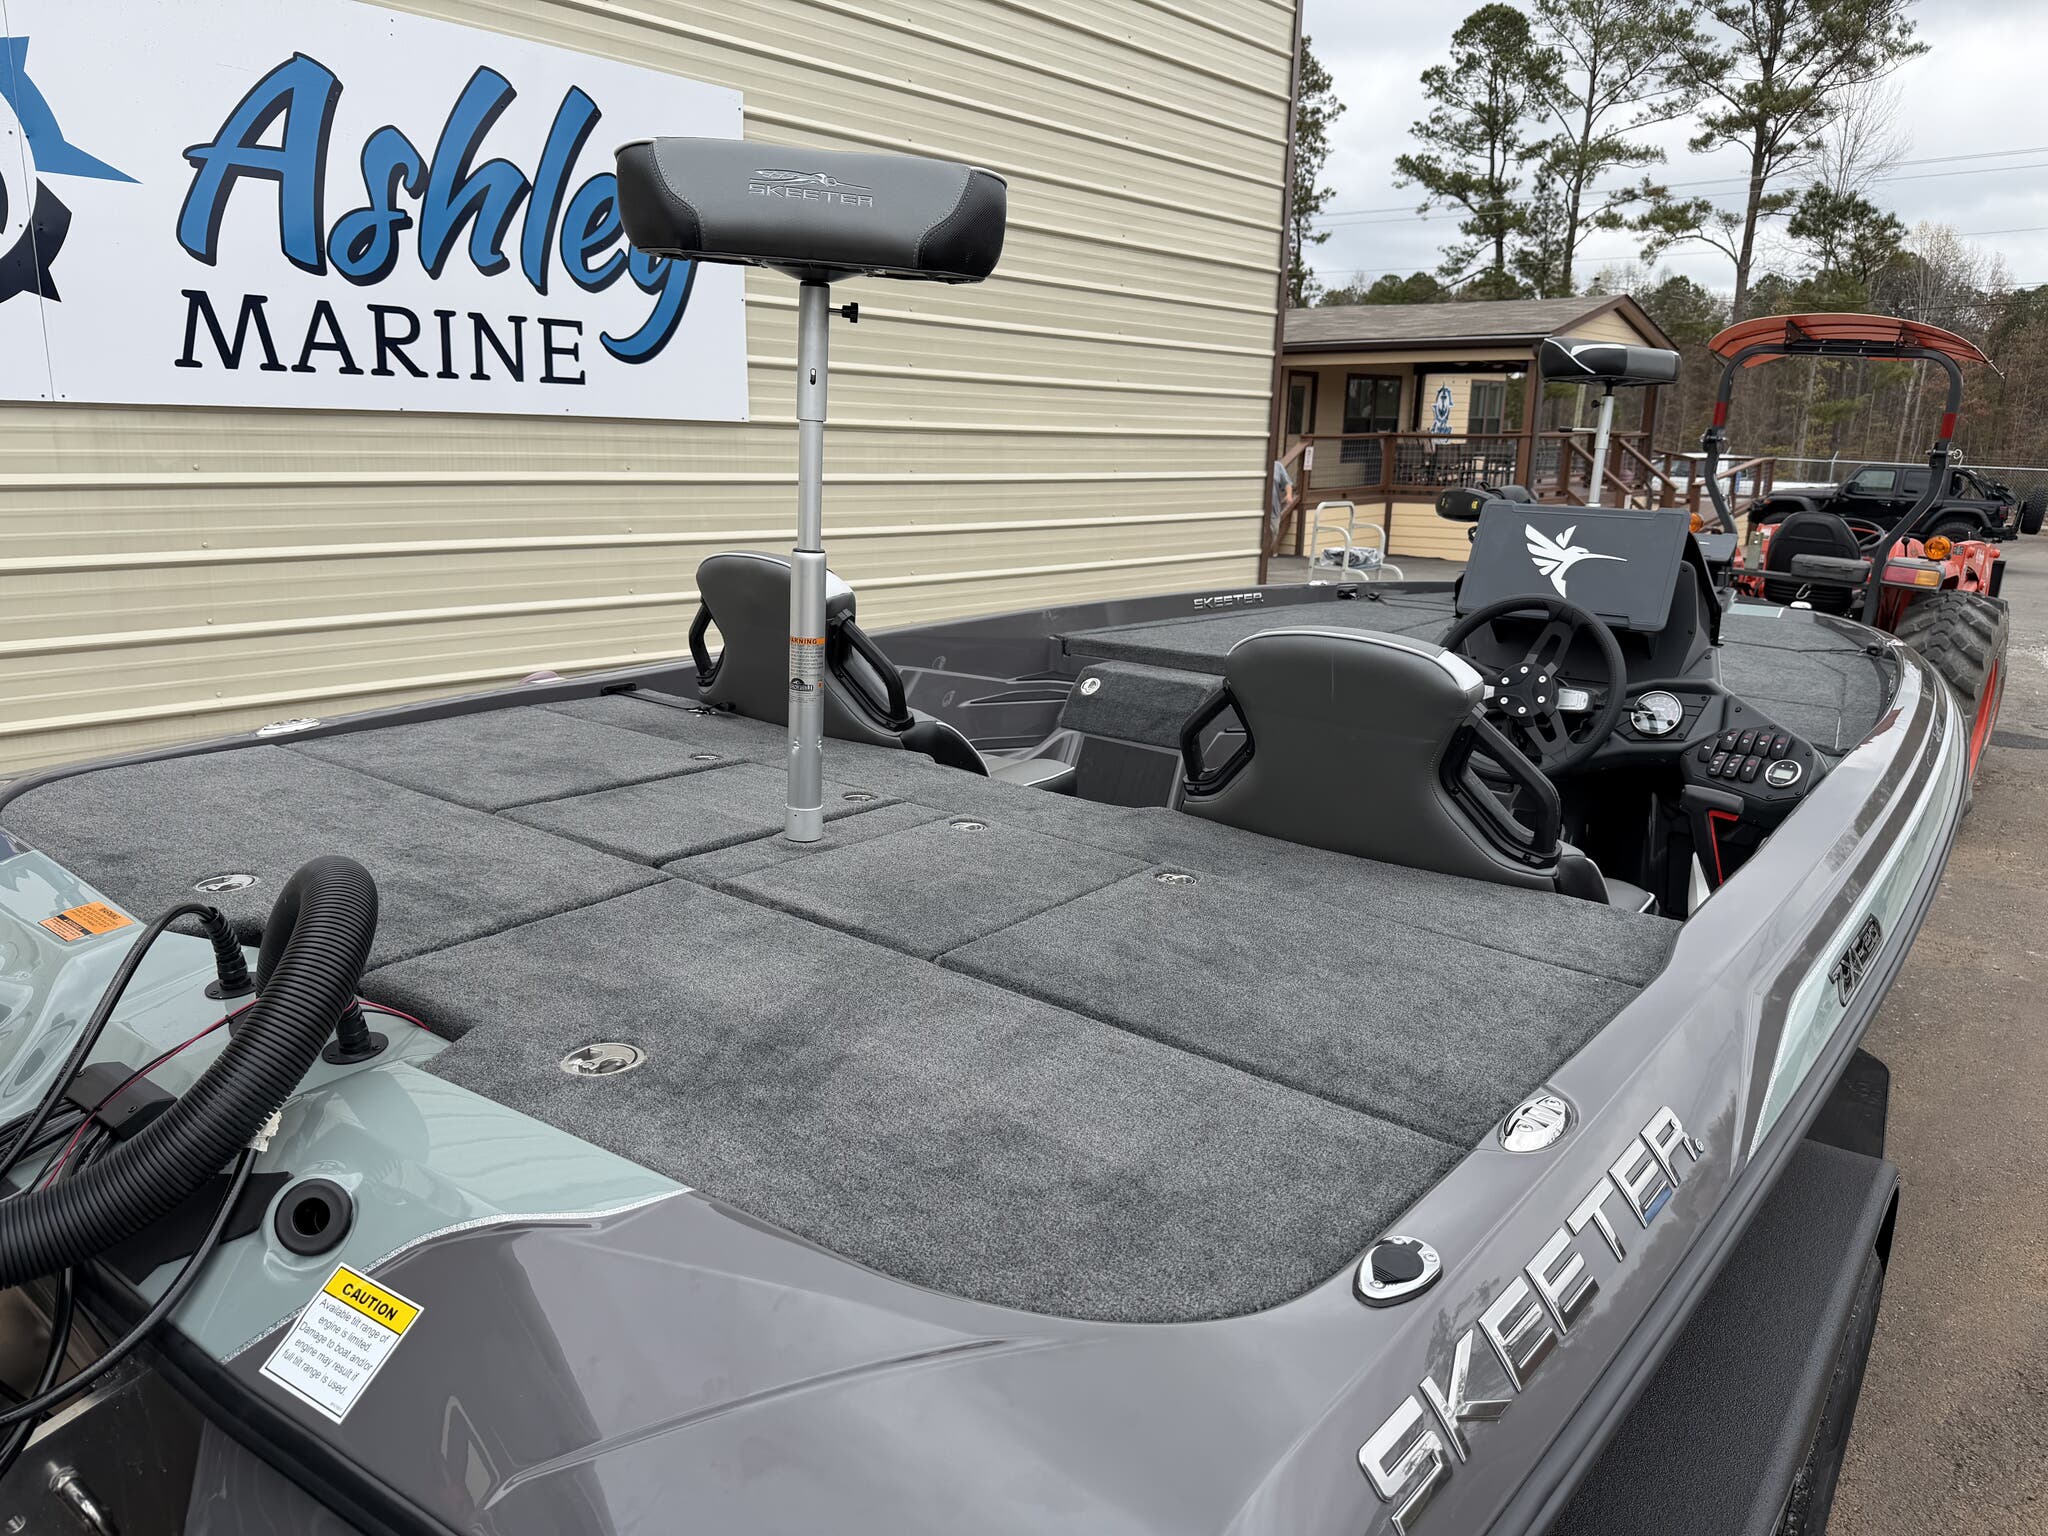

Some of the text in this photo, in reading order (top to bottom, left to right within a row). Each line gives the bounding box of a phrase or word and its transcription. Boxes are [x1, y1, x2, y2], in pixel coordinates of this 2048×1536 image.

[177, 51, 697, 364] Ashley
[748, 183, 873, 208] SKEETER
[174, 289, 587, 386] MARINE
[1193, 592, 1263, 610] SKEETER
[319, 1298, 391, 1344] Available tilt range of
[342, 1283, 398, 1321] CAUTION
[1357, 1105, 1700, 1536] SKEETER
[299, 1321, 373, 1371] Damage to boat and/or
[318, 1316, 341, 1331] engine
[341, 1328, 349, 1338] is
[282, 1348, 295, 1362] full
[292, 1354, 303, 1368] tilt
[300, 1362, 321, 1379] range
[320, 1371, 328, 1384] is
[294, 1339, 360, 1382] engine may result if
